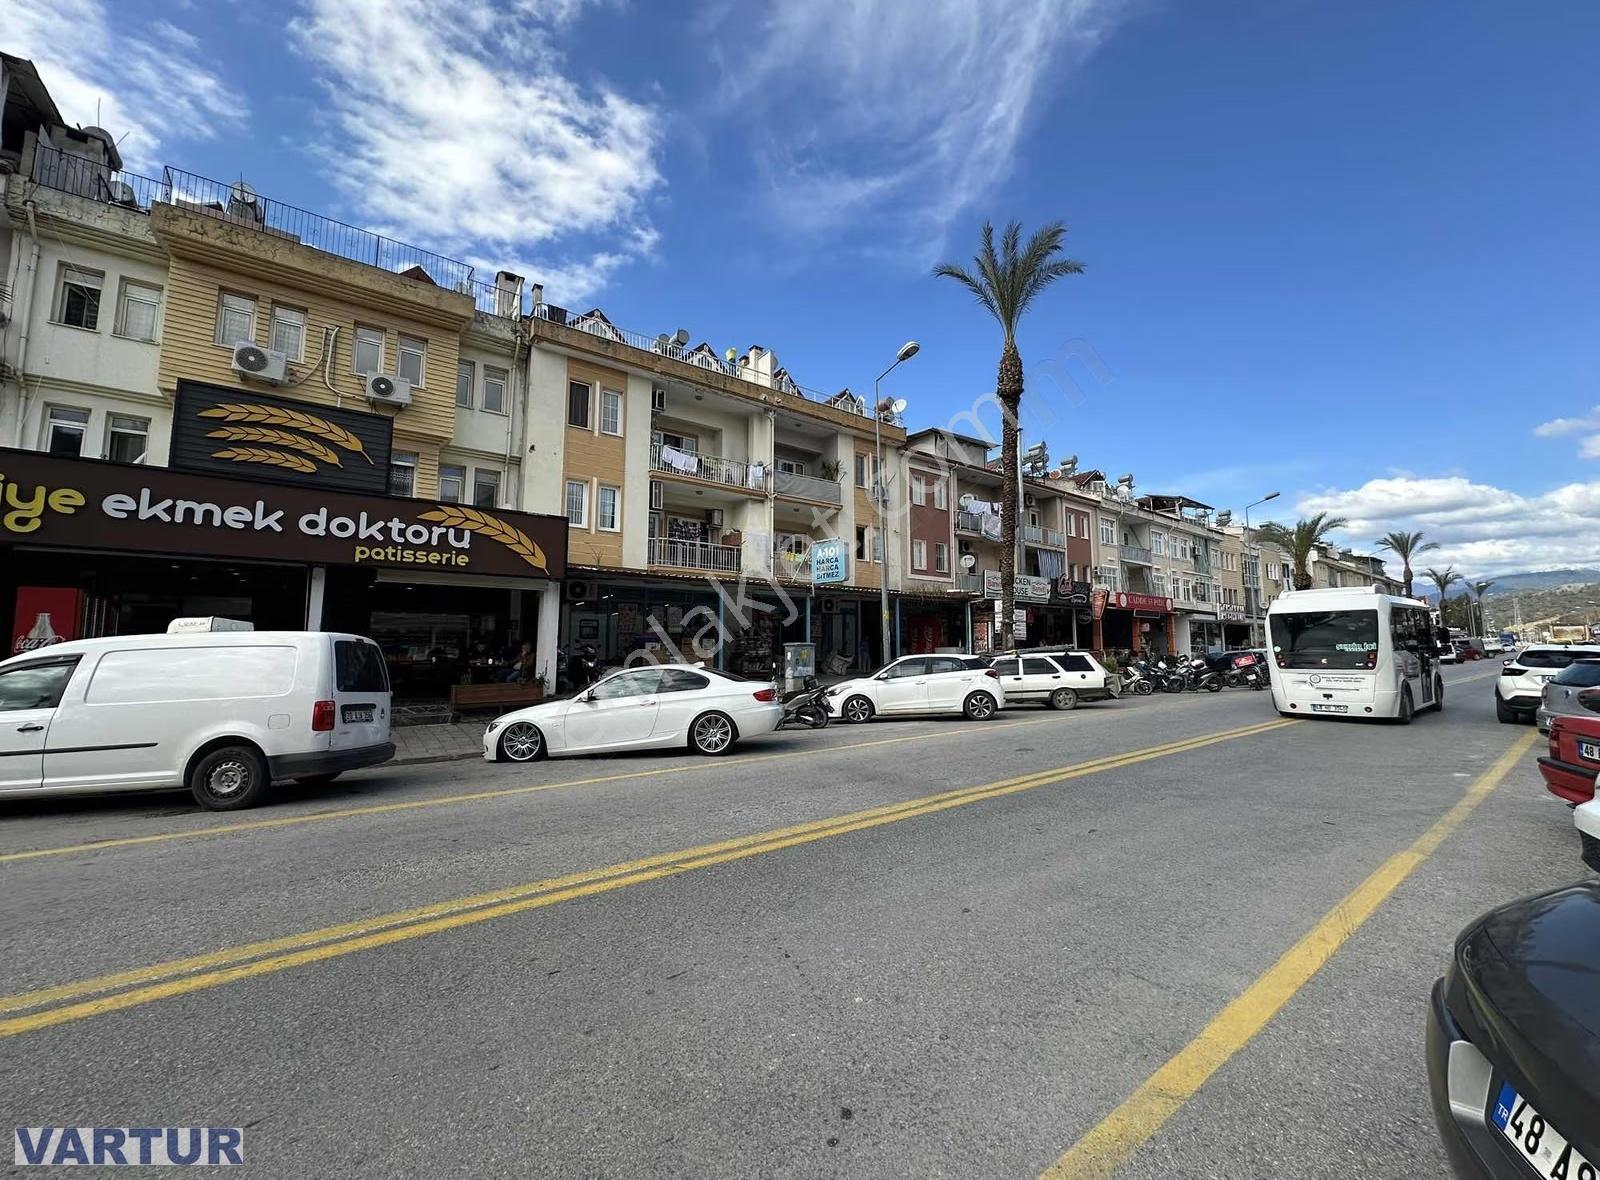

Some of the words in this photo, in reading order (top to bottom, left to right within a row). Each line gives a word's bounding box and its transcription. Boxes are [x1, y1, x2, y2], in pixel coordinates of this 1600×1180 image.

[102, 487, 284, 533] ekmek
[298, 507, 470, 549] doktoru
[354, 546, 469, 566] patisserie
[816, 557, 839, 565] HARCA
[816, 564, 839, 572] HARCA
[1498, 1103, 1508, 1122] TR
[1510, 1101, 1545, 1155] 48
